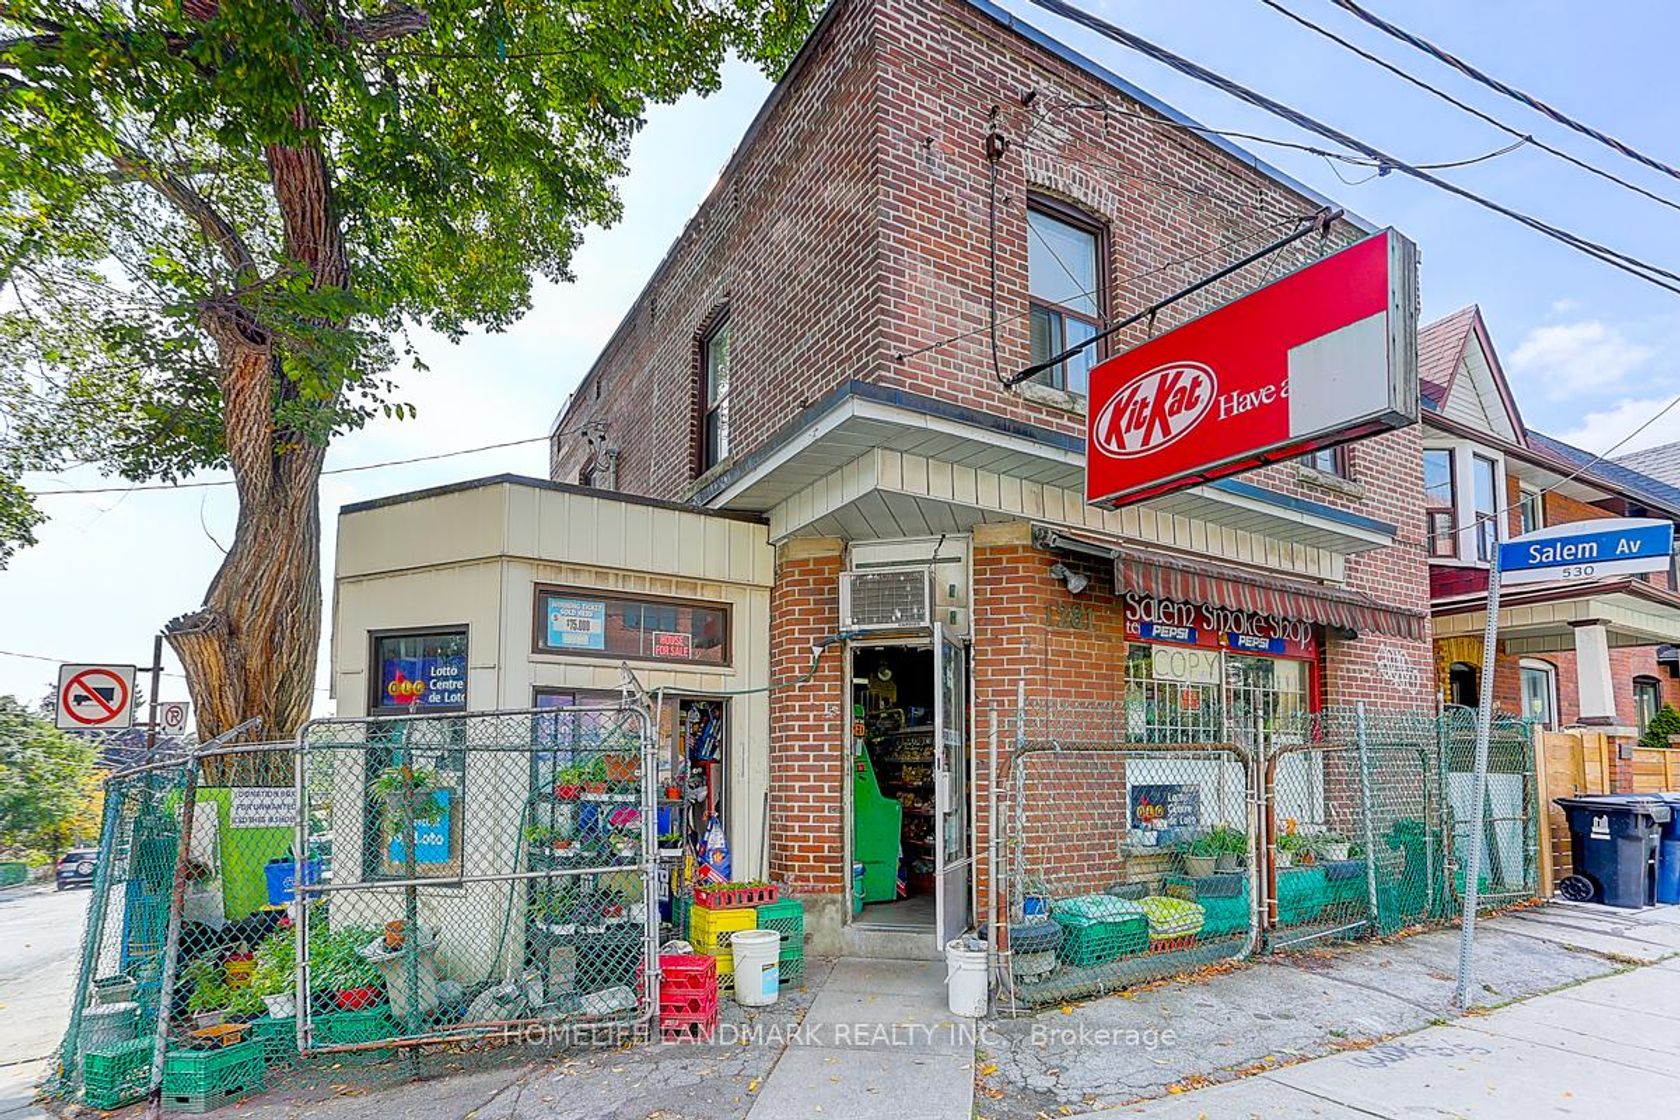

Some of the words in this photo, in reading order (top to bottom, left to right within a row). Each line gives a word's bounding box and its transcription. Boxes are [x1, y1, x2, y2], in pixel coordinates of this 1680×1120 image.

[1104, 370, 1202, 450] KitKat
[1218, 385, 1275, 421] Have
[1528, 542, 1597, 564] Salem
[1616, 538, 1641, 555] Av
[1562, 566, 1594, 578] 530
[1152, 625, 1189, 640] PEPSI
[1202, 605, 1267, 636] Smoke
[1270, 615, 1312, 649] Shop
[659, 635, 684, 645] HOUSE
[1238, 636, 1269, 650] PEPSI
[655, 645, 669, 655] FOR
[670, 646, 689, 657] SALE
[1154, 649, 1219, 680] COPY
[430, 666, 458, 677] Lotto
[429, 680, 464, 690] Centre
[428, 692, 441, 703] de
